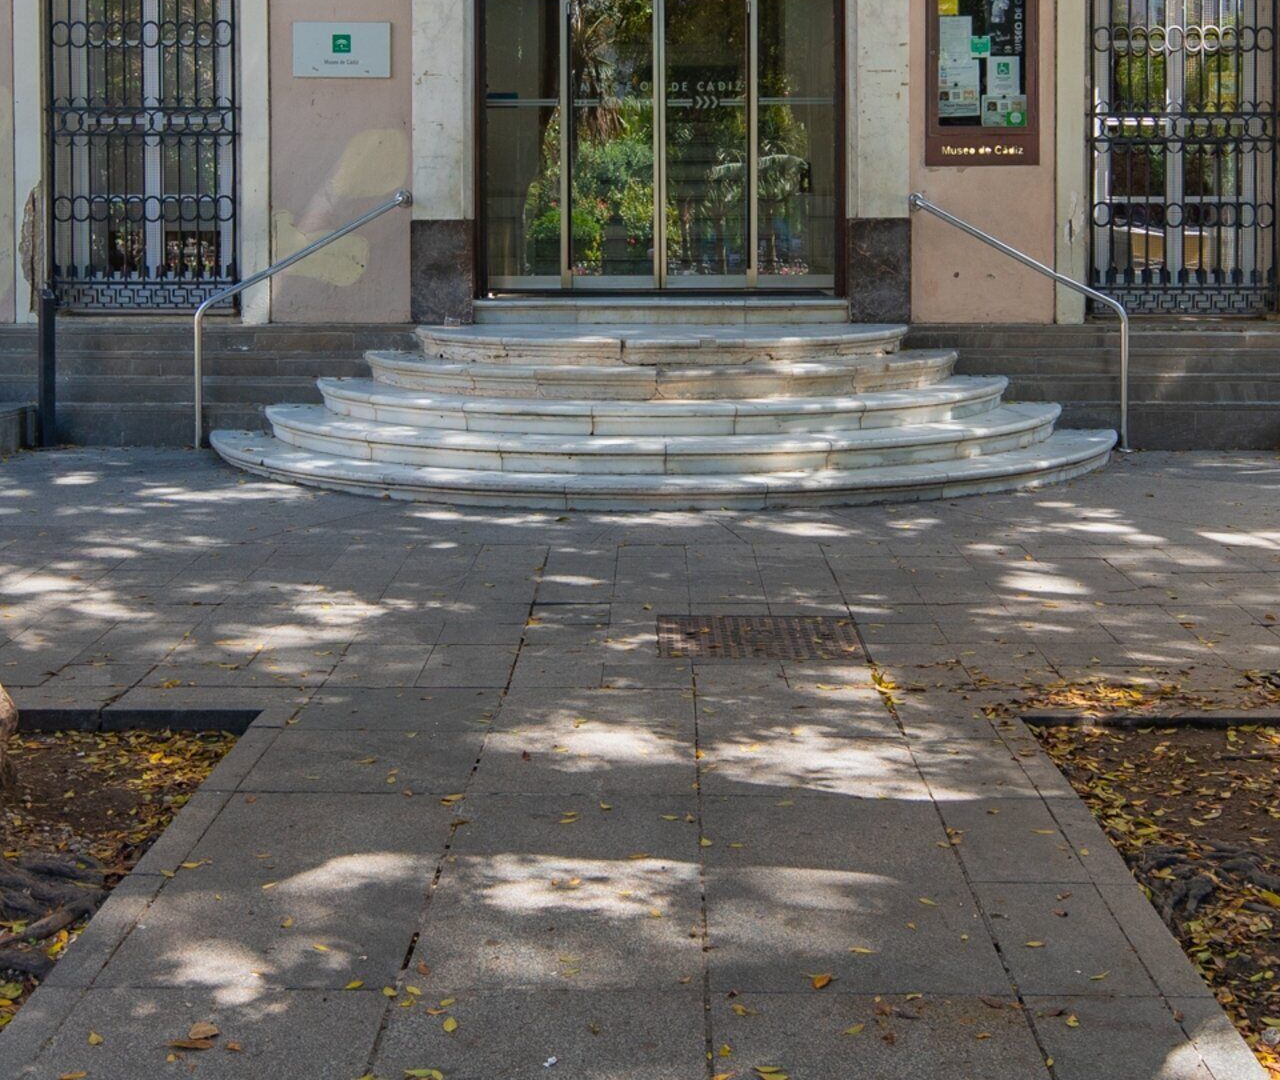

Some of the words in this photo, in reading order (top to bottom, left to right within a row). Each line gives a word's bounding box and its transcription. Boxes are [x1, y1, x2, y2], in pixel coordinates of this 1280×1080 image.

[671, 81, 689, 92] DE
[941, 145, 976, 155] Museo
[978, 145, 992, 155] de
